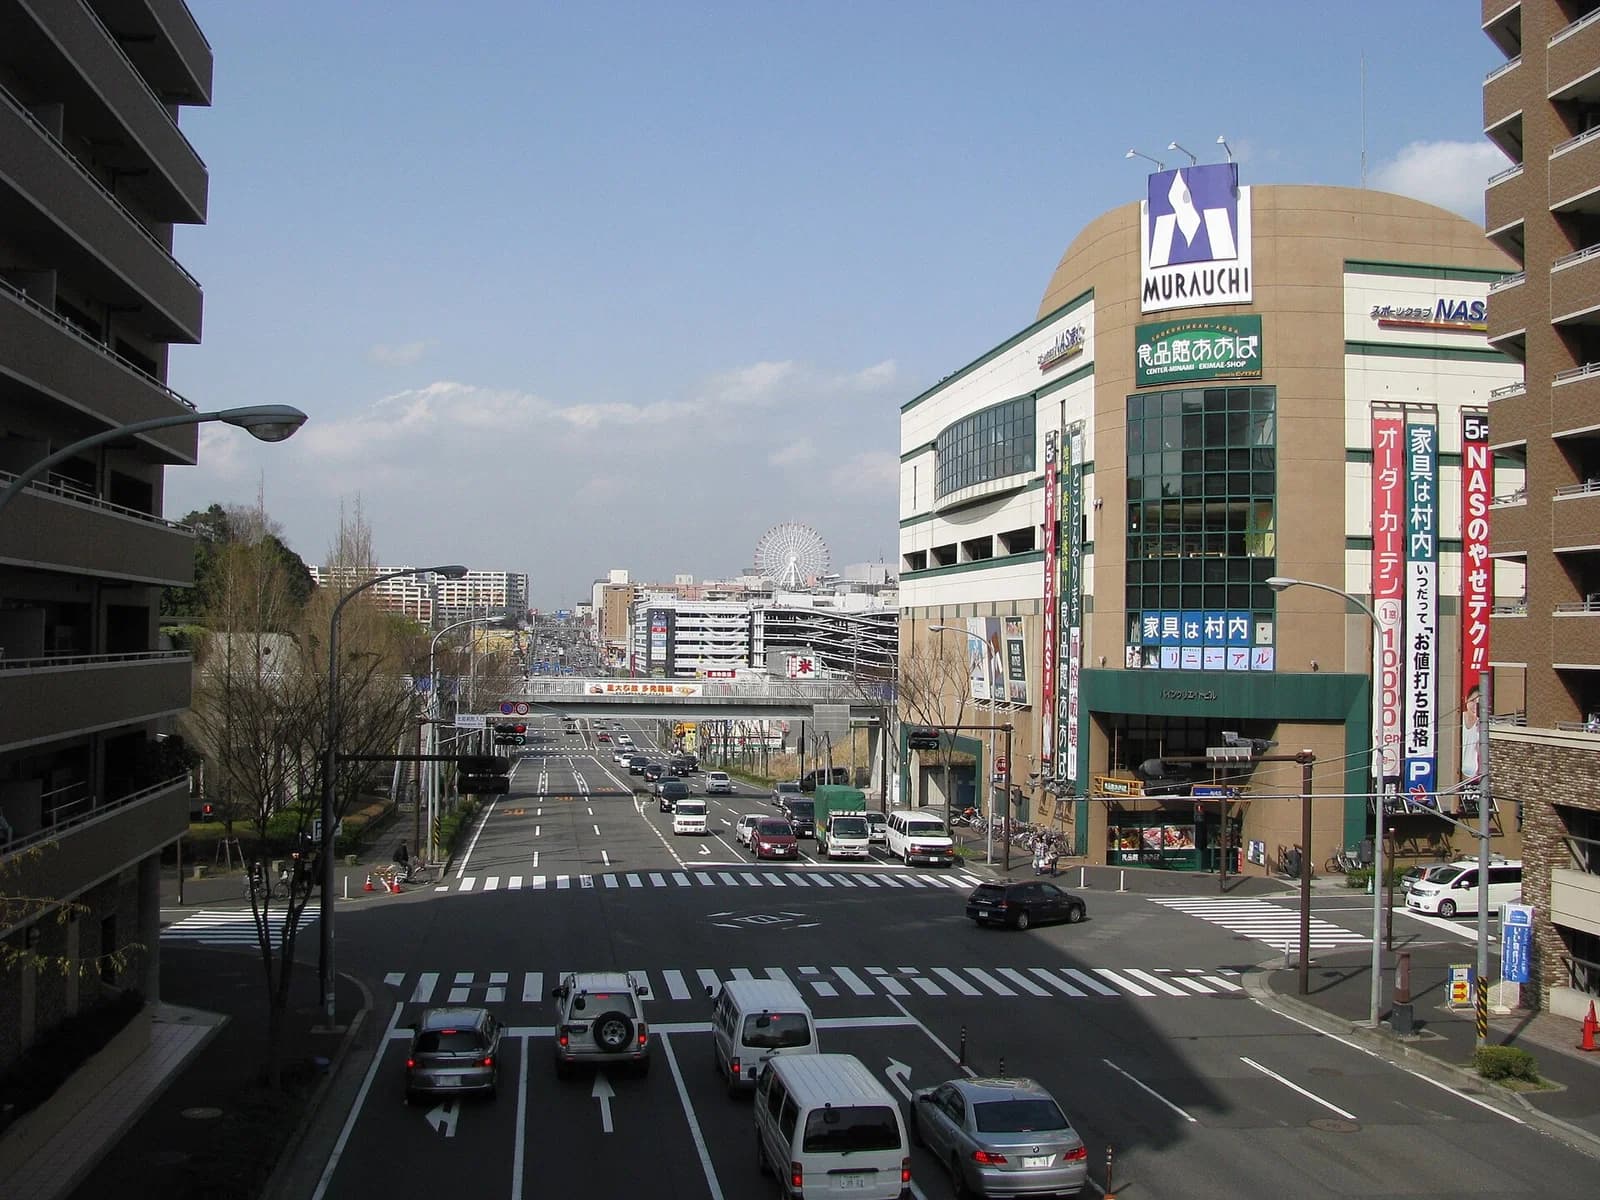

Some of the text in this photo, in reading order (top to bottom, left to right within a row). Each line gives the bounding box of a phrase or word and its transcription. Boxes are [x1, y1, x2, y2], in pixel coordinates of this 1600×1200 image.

[1143, 267, 1249, 304] MURAUCHI
[1371, 299, 1488, 322] スポーツクラブ NAS
[1137, 335, 1259, 368] 食品館あおば
[1146, 360, 1247, 375] CENTER-MINAMI EKIMAE-SHOP
[1410, 427, 1433, 559] 家具は村内
[1378, 427, 1399, 595] オーダーカーテン
[1143, 616, 1248, 640] 家具は村内
[1171, 652, 1269, 665] リニューアル
[1410, 761, 1430, 781] P
